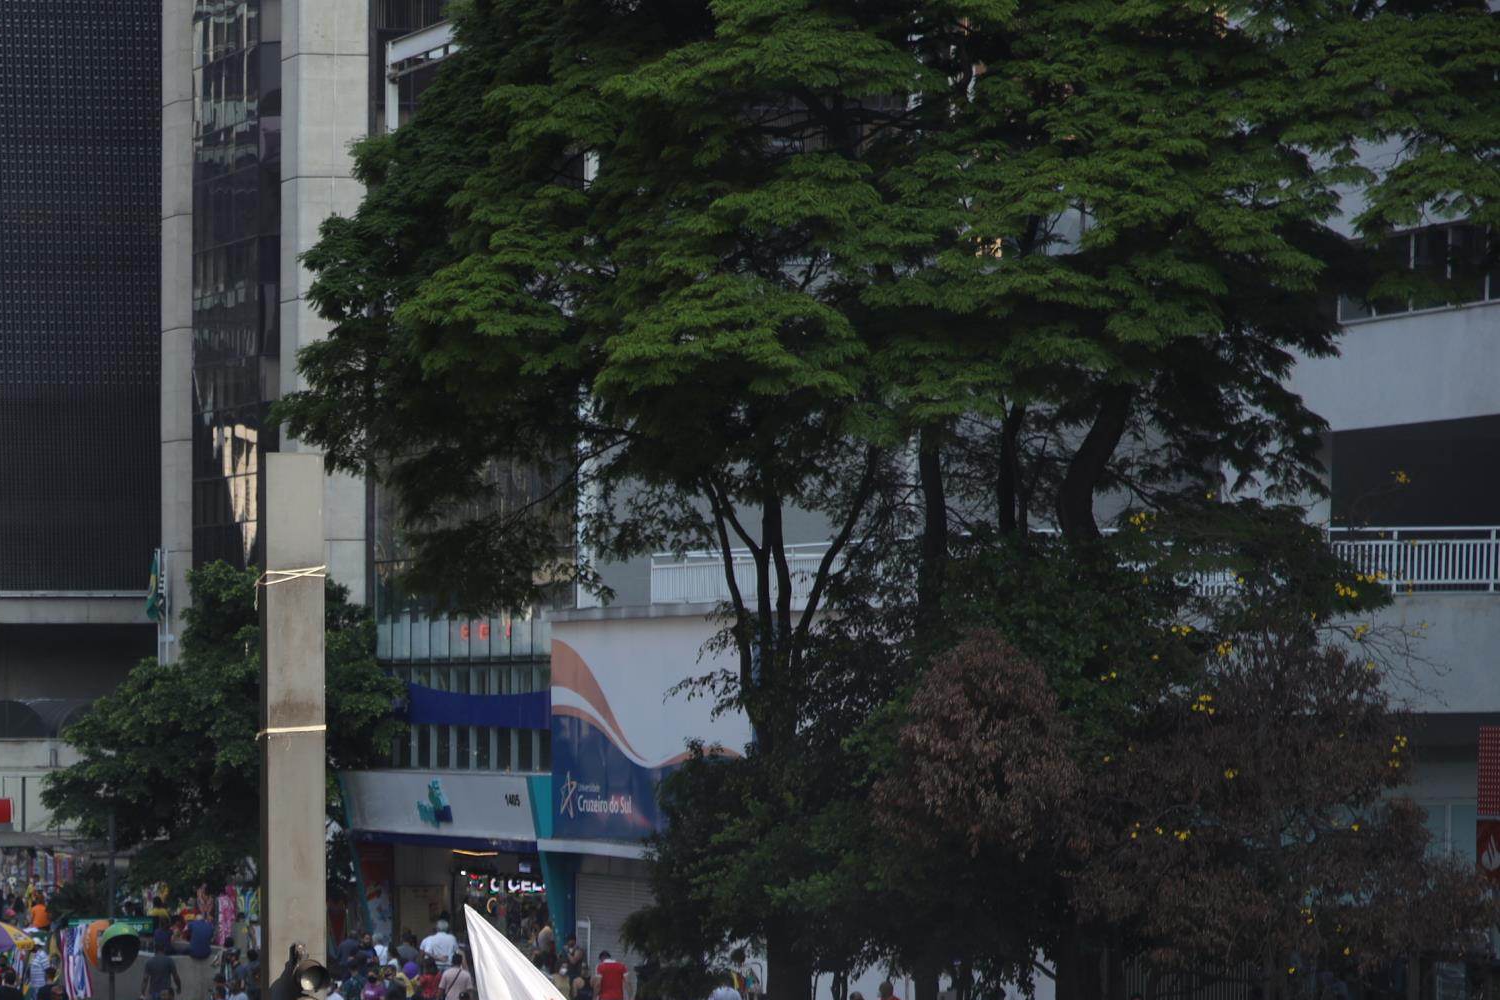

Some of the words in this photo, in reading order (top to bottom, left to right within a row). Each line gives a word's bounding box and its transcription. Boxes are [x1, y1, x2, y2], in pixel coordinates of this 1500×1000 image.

[578, 795, 608, 813] Cruzeiro
[610, 797, 620, 813] do
[621, 796, 633, 814] Sul
